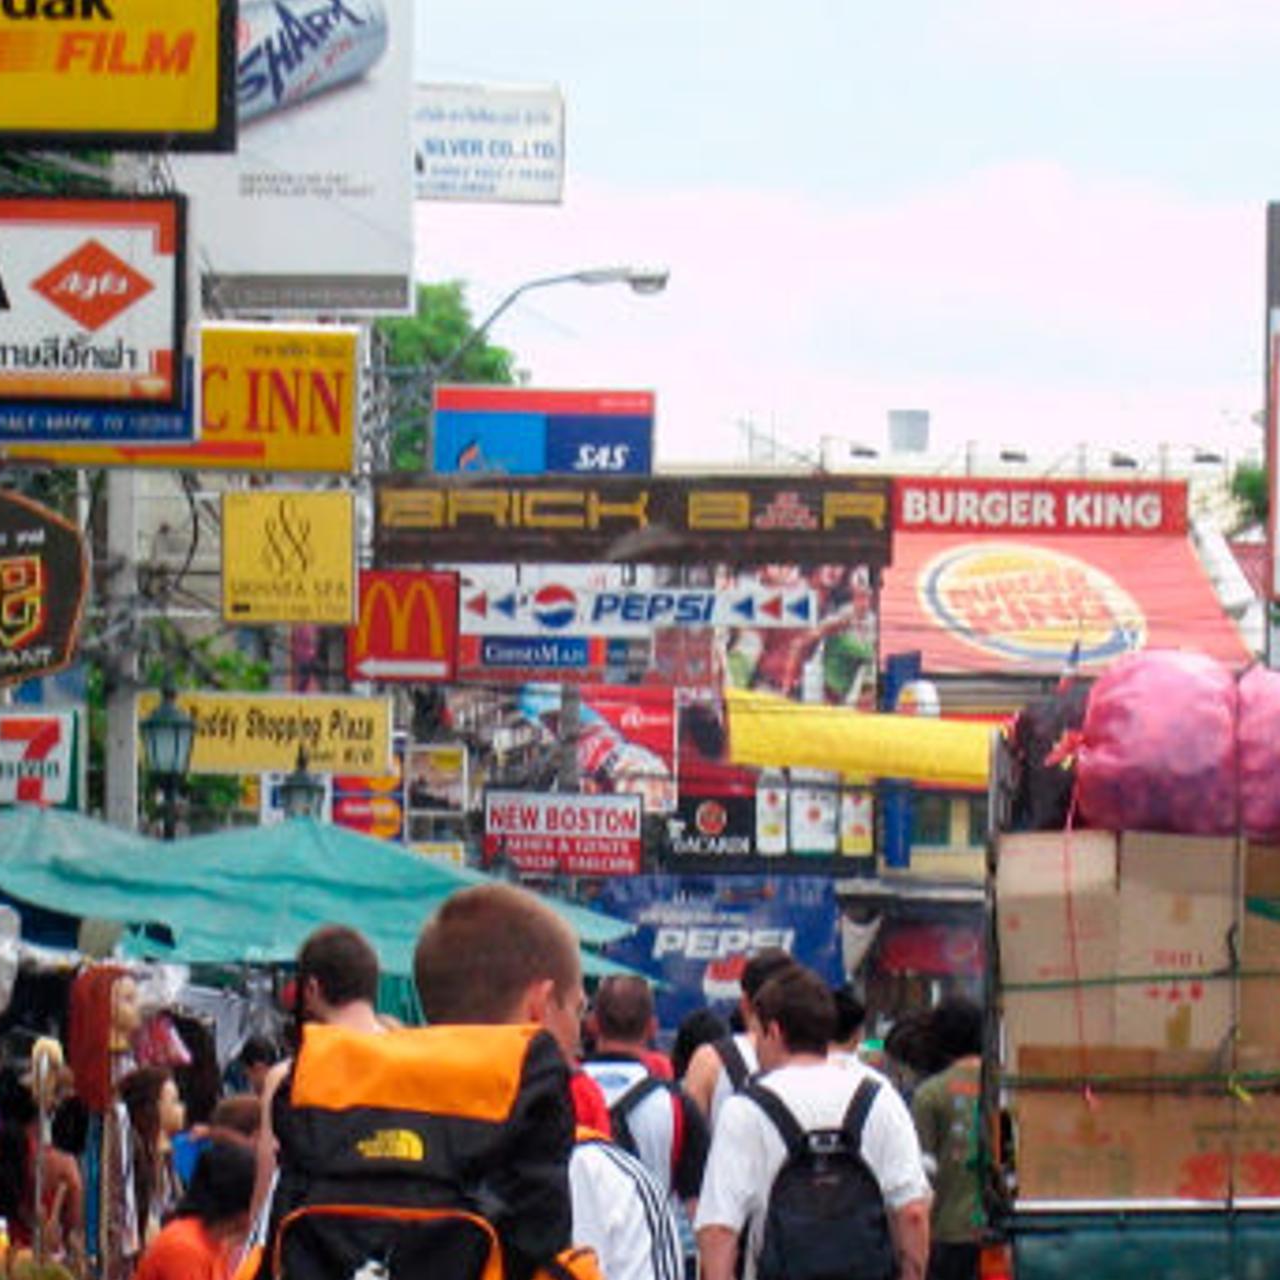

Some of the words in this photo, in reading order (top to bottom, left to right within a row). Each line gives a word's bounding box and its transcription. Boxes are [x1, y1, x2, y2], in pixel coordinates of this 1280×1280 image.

[53, 30, 194, 74] FILM
[243, 367, 345, 436] INN
[574, 444, 629, 470] SAS
[902, 488, 1056, 526] BURGER
[1066, 491, 1162, 528] KING
[591, 592, 718, 622] PEPSI
[192, 704, 237, 741] uddy
[328, 708, 376, 741] Plaza
[488, 806, 540, 833] NEW
[546, 805, 639, 834] BOSTON
[651, 929, 796, 959] PEPSI
